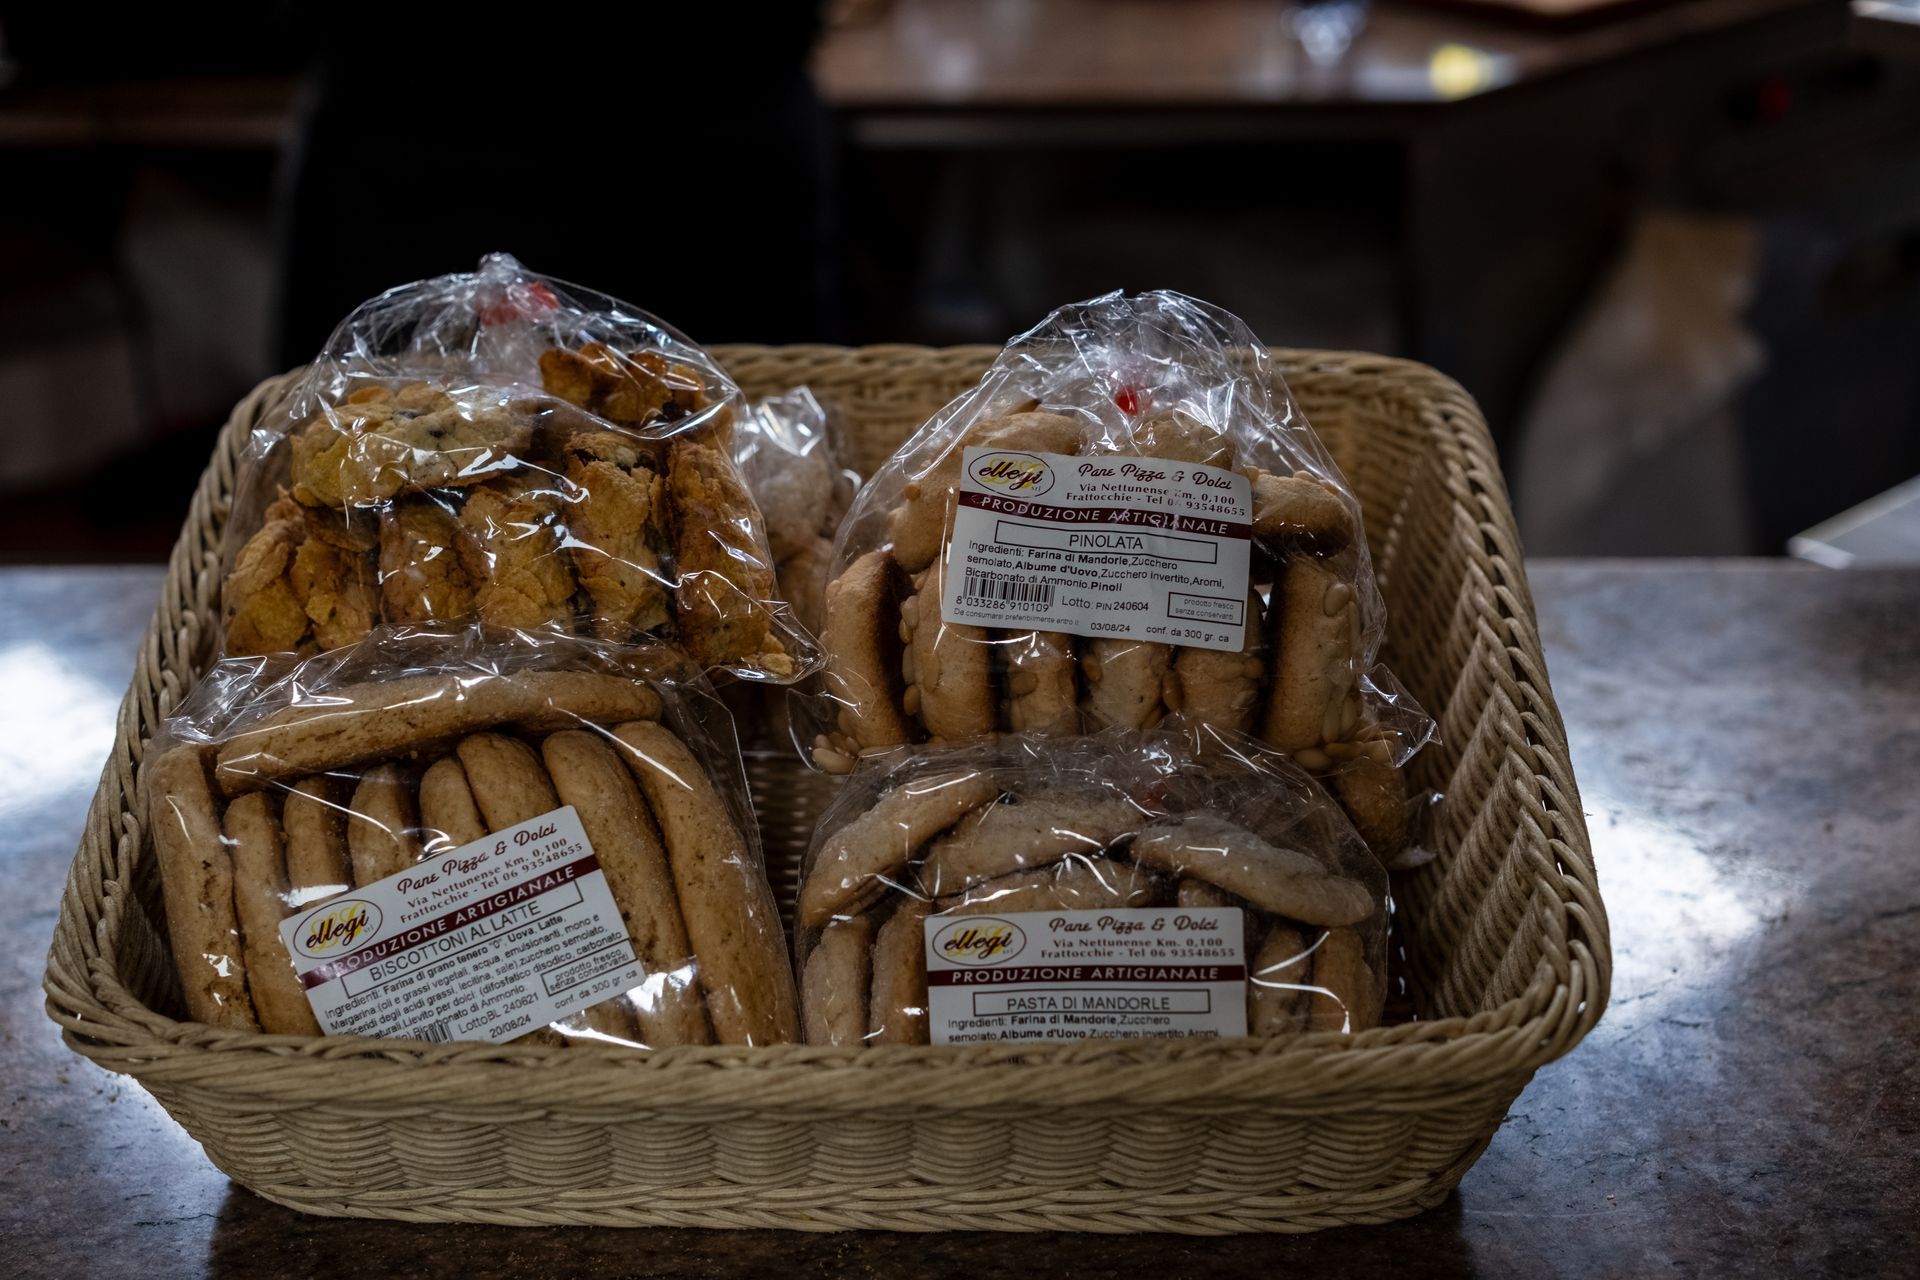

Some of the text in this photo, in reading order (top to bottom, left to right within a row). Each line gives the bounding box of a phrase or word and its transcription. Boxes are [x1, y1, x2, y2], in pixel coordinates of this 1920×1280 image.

[979, 461, 1044, 491] ellegi
[1078, 463, 1232, 490] Pane Pizza & Dolci
[1066, 492, 1132, 502] Frattocchie
[1146, 495, 1163, 505] Tel
[1186, 501, 1246, 517] 93548655
[1080, 484, 1096, 492] Via
[1101, 484, 1169, 496] Nettunense
[1201, 493, 1235, 505] 0,100
[981, 496, 1228, 535] PRODUZIONE ARTIGIANALE
[968, 540, 1025, 558] Ingredienti:
[1028, 550, 1061, 560] Farina
[1065, 553, 1075, 562] di
[1069, 534, 1144, 550] PINOLATA
[965, 567, 1025, 583] Bicarbonato
[1028, 575, 1038, 584] di
[956, 596, 1050, 613] 8 033286 910109
[1062, 596, 1093, 609] Lotto:
[1175, 607, 1195, 616] senza
[1213, 600, 1235, 610] fresco
[1090, 622, 1230, 643] 03/08/24 conf. da 300 gr. ca
[397, 823, 557, 895] Pane Pizza & Dolci
[400, 891, 469, 923] Frattocchie
[480, 877, 499, 890] Tel
[503, 870, 519, 881] 06
[521, 843, 583, 872] 93548655
[407, 838, 567, 909] Via Nettunense Km. 0,100
[455, 866, 575, 925] ARTIGIANALE
[305, 909, 369, 948] ellegi
[1049, 915, 1219, 935] Pane Pizza & Dolci
[369, 900, 541, 982] BISCOTTONI AL LATTE
[944, 929, 1013, 959] ellegi
[1041, 949, 1114, 958] Frattocchie
[1128, 948, 1145, 957] Tel
[1150, 949, 1166, 957] 06
[1171, 948, 1235, 957] 93548655
[1053, 938, 1223, 948] Via Nettunense Km. 0,100
[402, 984, 431, 1002] grassi
[564, 918, 591, 934] mono
[549, 952, 630, 991] senza conservanti
[554, 949, 622, 981] prodotto fresco
[324, 989, 382, 1019] Ingredienti:
[383, 976, 414, 995] Farina
[416, 970, 425, 981] di
[427, 959, 456, 979] grano
[456, 946, 488, 964] tenero
[436, 1002, 451, 1016] per
[576, 931, 622, 955] carbonato
[952, 967, 1219, 983] PRODUZIONE ARTIGIANALE
[379, 1008, 401, 1025] degli
[402, 998, 425, 1015] acidi
[470, 1002, 480, 1013] di
[489, 1014, 532, 1038] 20/08/24
[579, 989, 591, 999] da
[592, 980, 610, 993] 300
[625, 970, 638, 979] ca
[1007, 996, 1171, 1011] PASTA DI MANDORLE
[948, 1017, 1007, 1031] Ingredienti:
[1011, 1015, 1046, 1025] Farina
[1049, 1014, 1060, 1024] di
